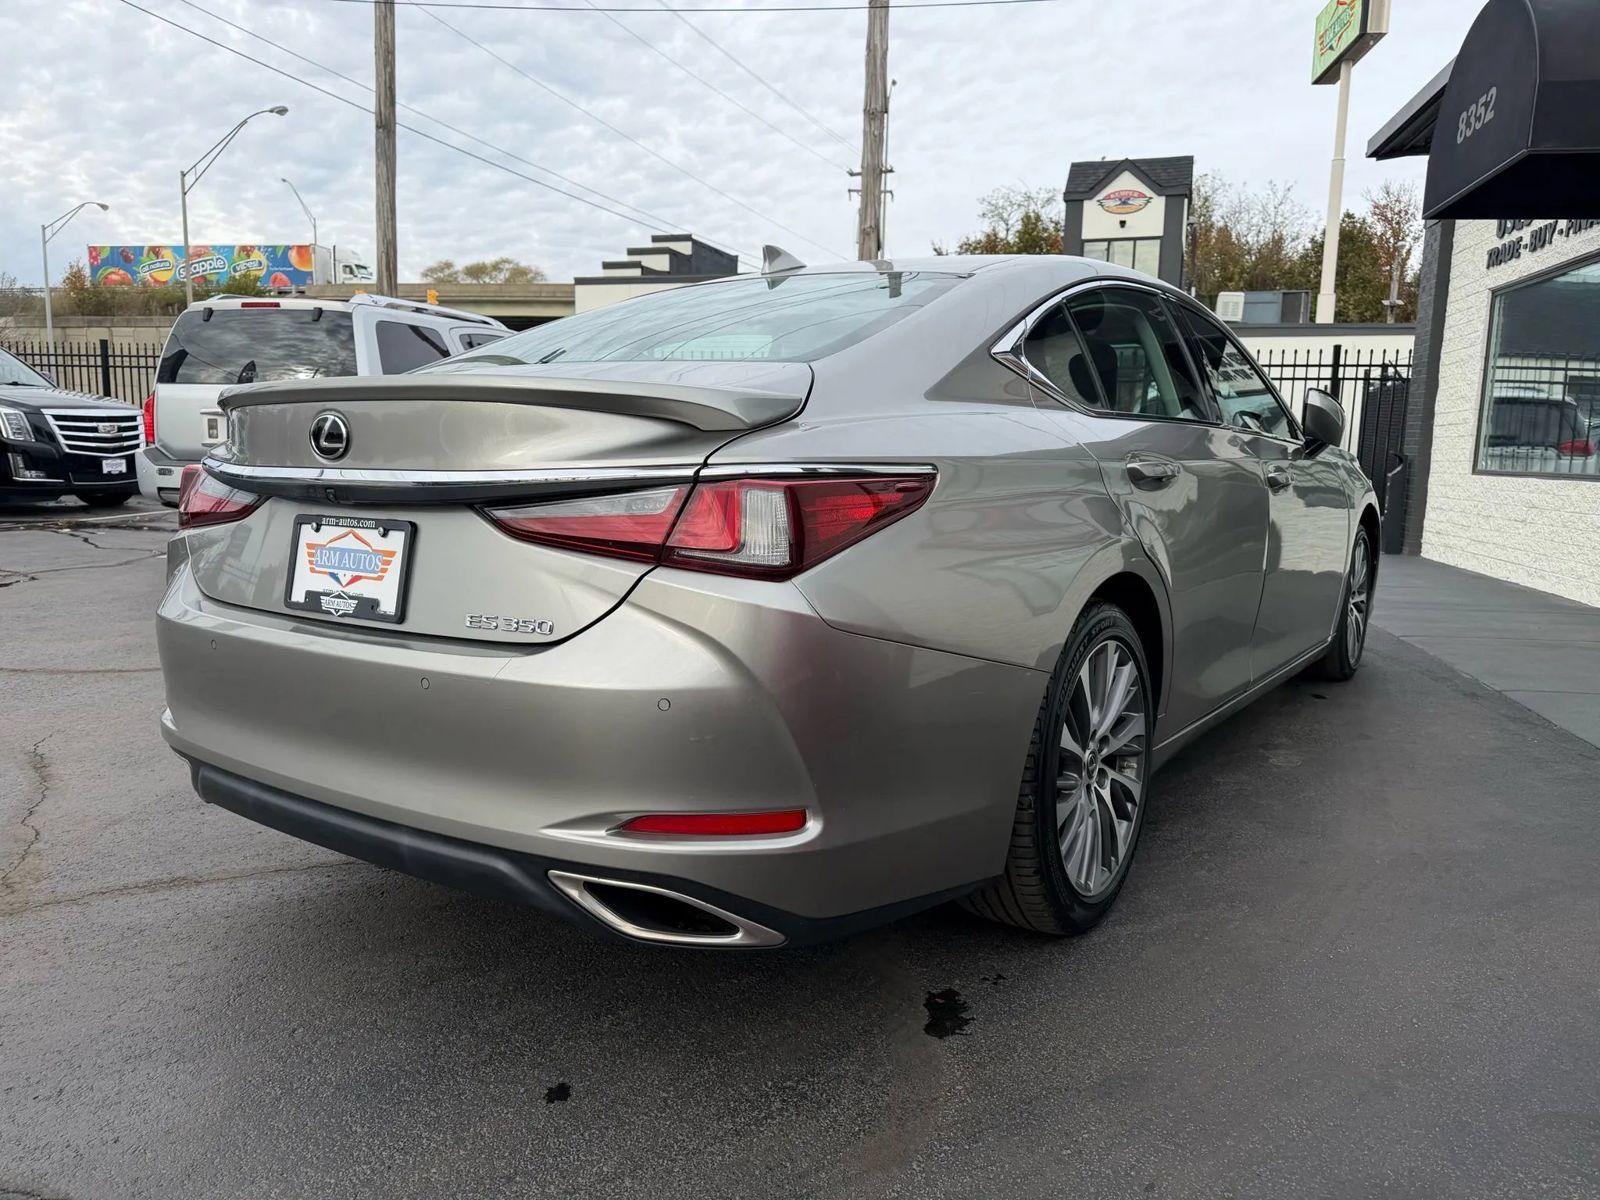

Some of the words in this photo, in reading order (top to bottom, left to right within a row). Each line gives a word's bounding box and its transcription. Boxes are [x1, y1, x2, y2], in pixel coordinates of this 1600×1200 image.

[1457, 86, 1497, 144] 8352
[1486, 236, 1523, 270] TRADE
[1529, 219, 1559, 252] BUY
[179, 256, 224, 278] Sapple
[322, 517, 376, 528] arm-autos.com
[315, 548, 340, 567] ARM
[341, 551, 383, 572] AUTOS
[465, 613, 498, 630] ES
[501, 617, 554, 635] 350
